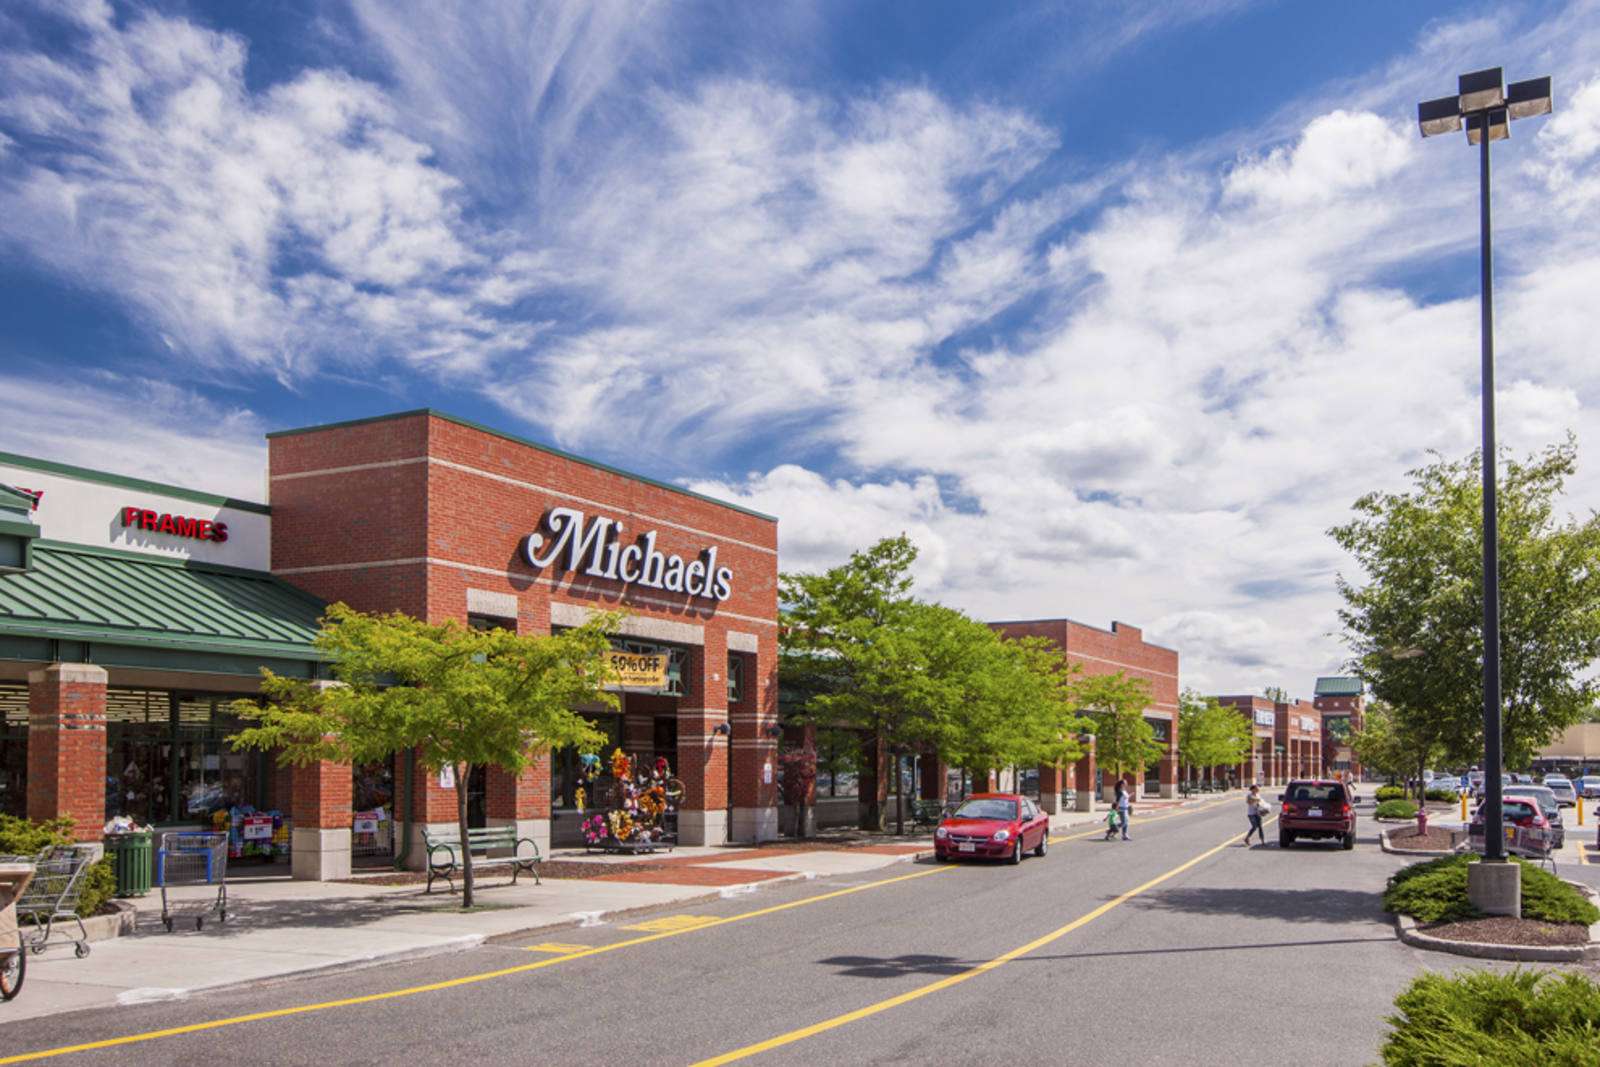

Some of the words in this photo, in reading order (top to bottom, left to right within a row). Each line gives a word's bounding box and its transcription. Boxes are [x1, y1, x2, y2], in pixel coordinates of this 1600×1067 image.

[123, 506, 228, 542] FRAMES
[527, 506, 734, 601] Michaels
[639, 657, 659, 672] OFF
